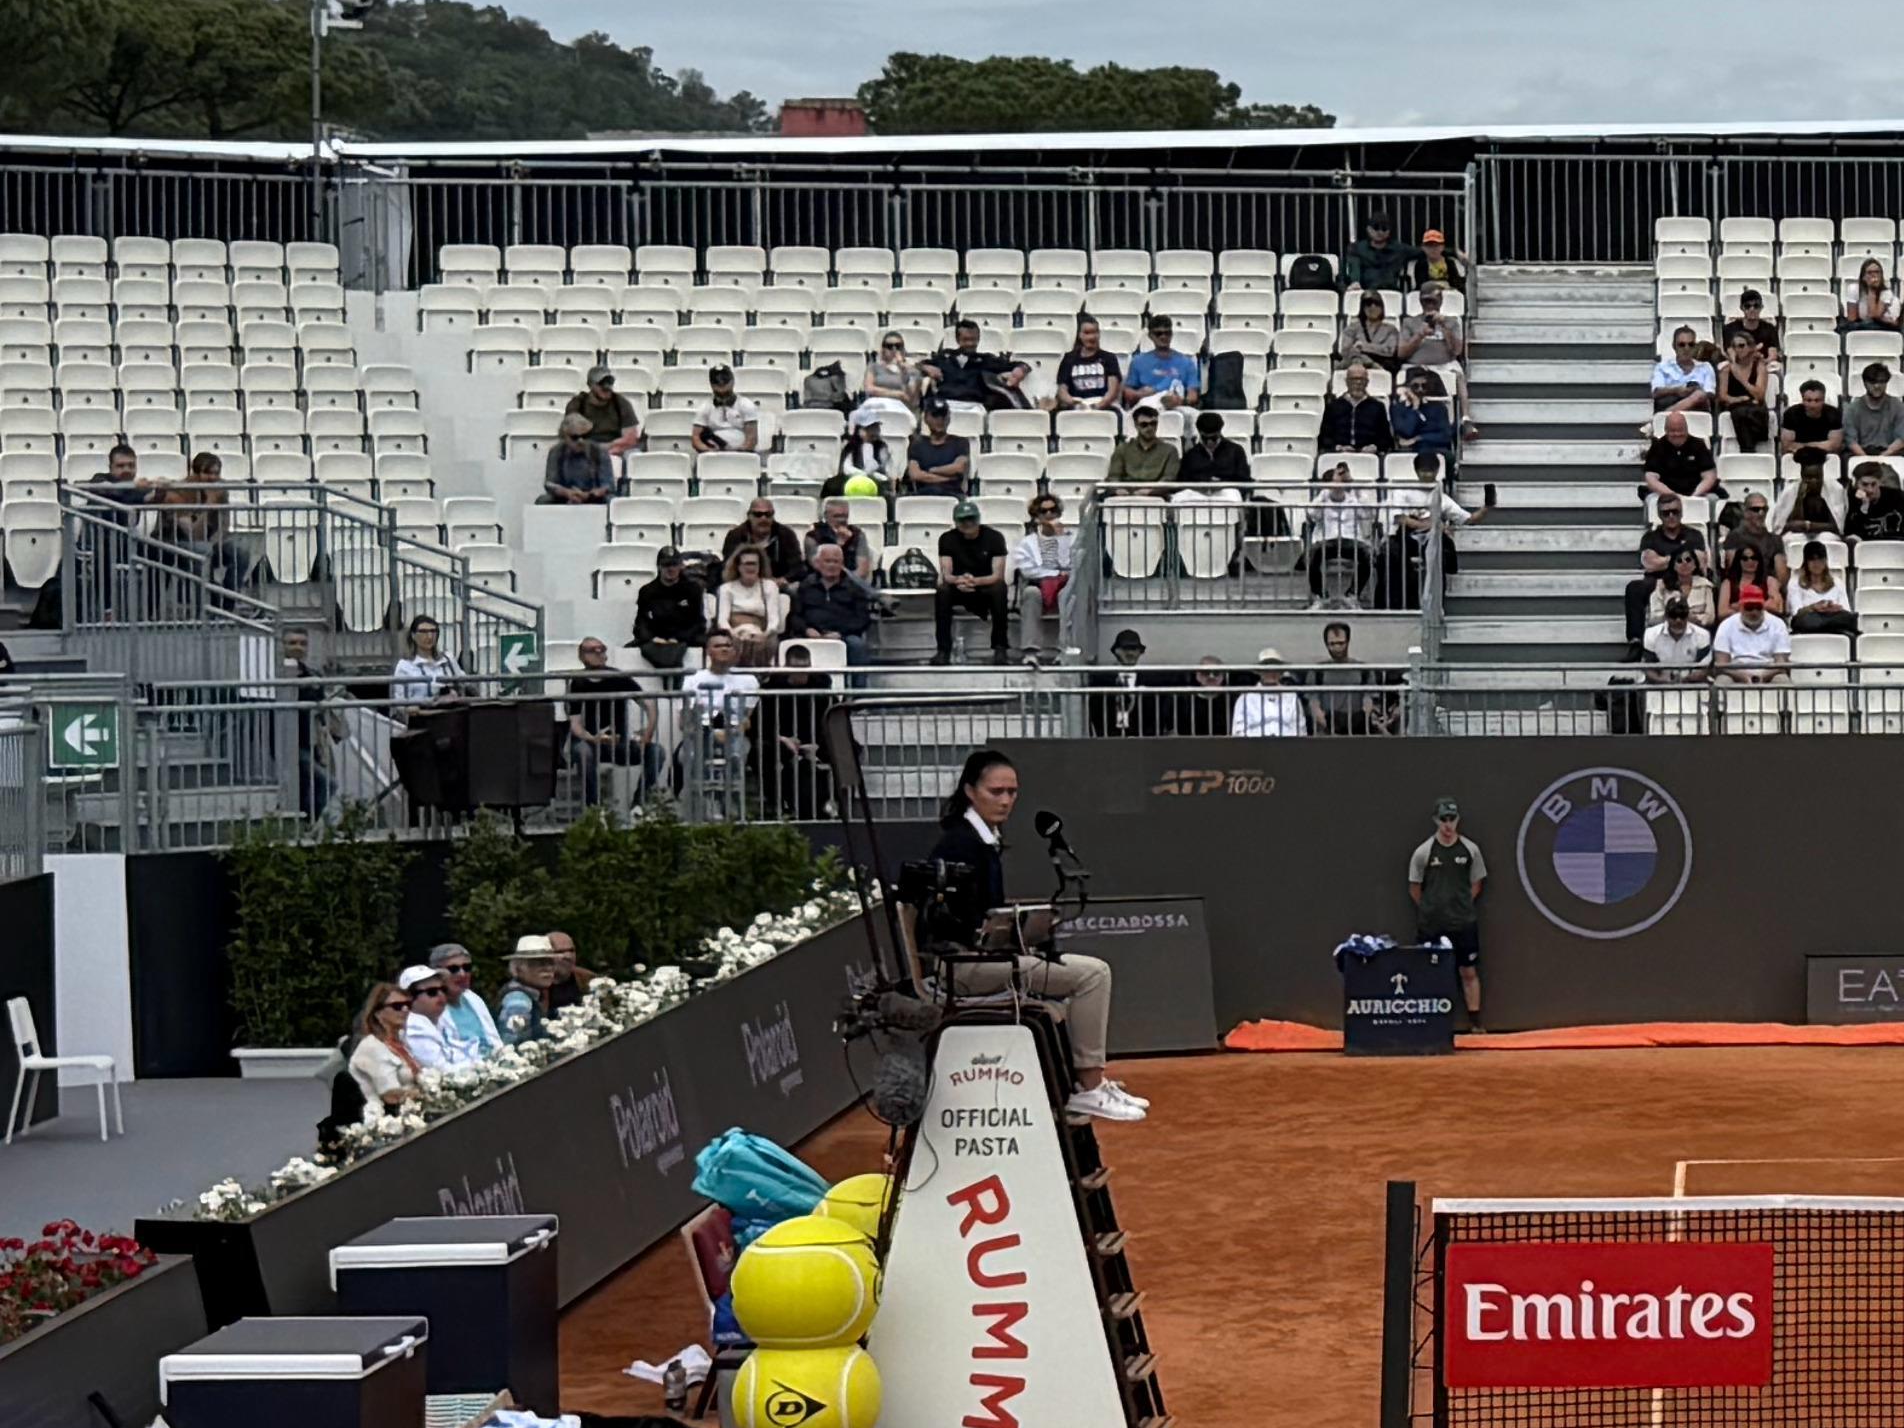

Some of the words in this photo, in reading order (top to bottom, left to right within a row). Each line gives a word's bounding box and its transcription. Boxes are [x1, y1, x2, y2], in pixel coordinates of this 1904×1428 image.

[1151, 771, 1224, 795] ATP
[1227, 775, 1275, 794] 1000
[1541, 777, 1669, 823] BMW
[1347, 999, 1452, 1014] AURICCHIO
[950, 1067, 1025, 1087] RUMMO
[941, 1108, 1033, 1128] OFFICIAL
[955, 1137, 1019, 1157] PASTA
[1463, 1280, 1756, 1341] Emirates
